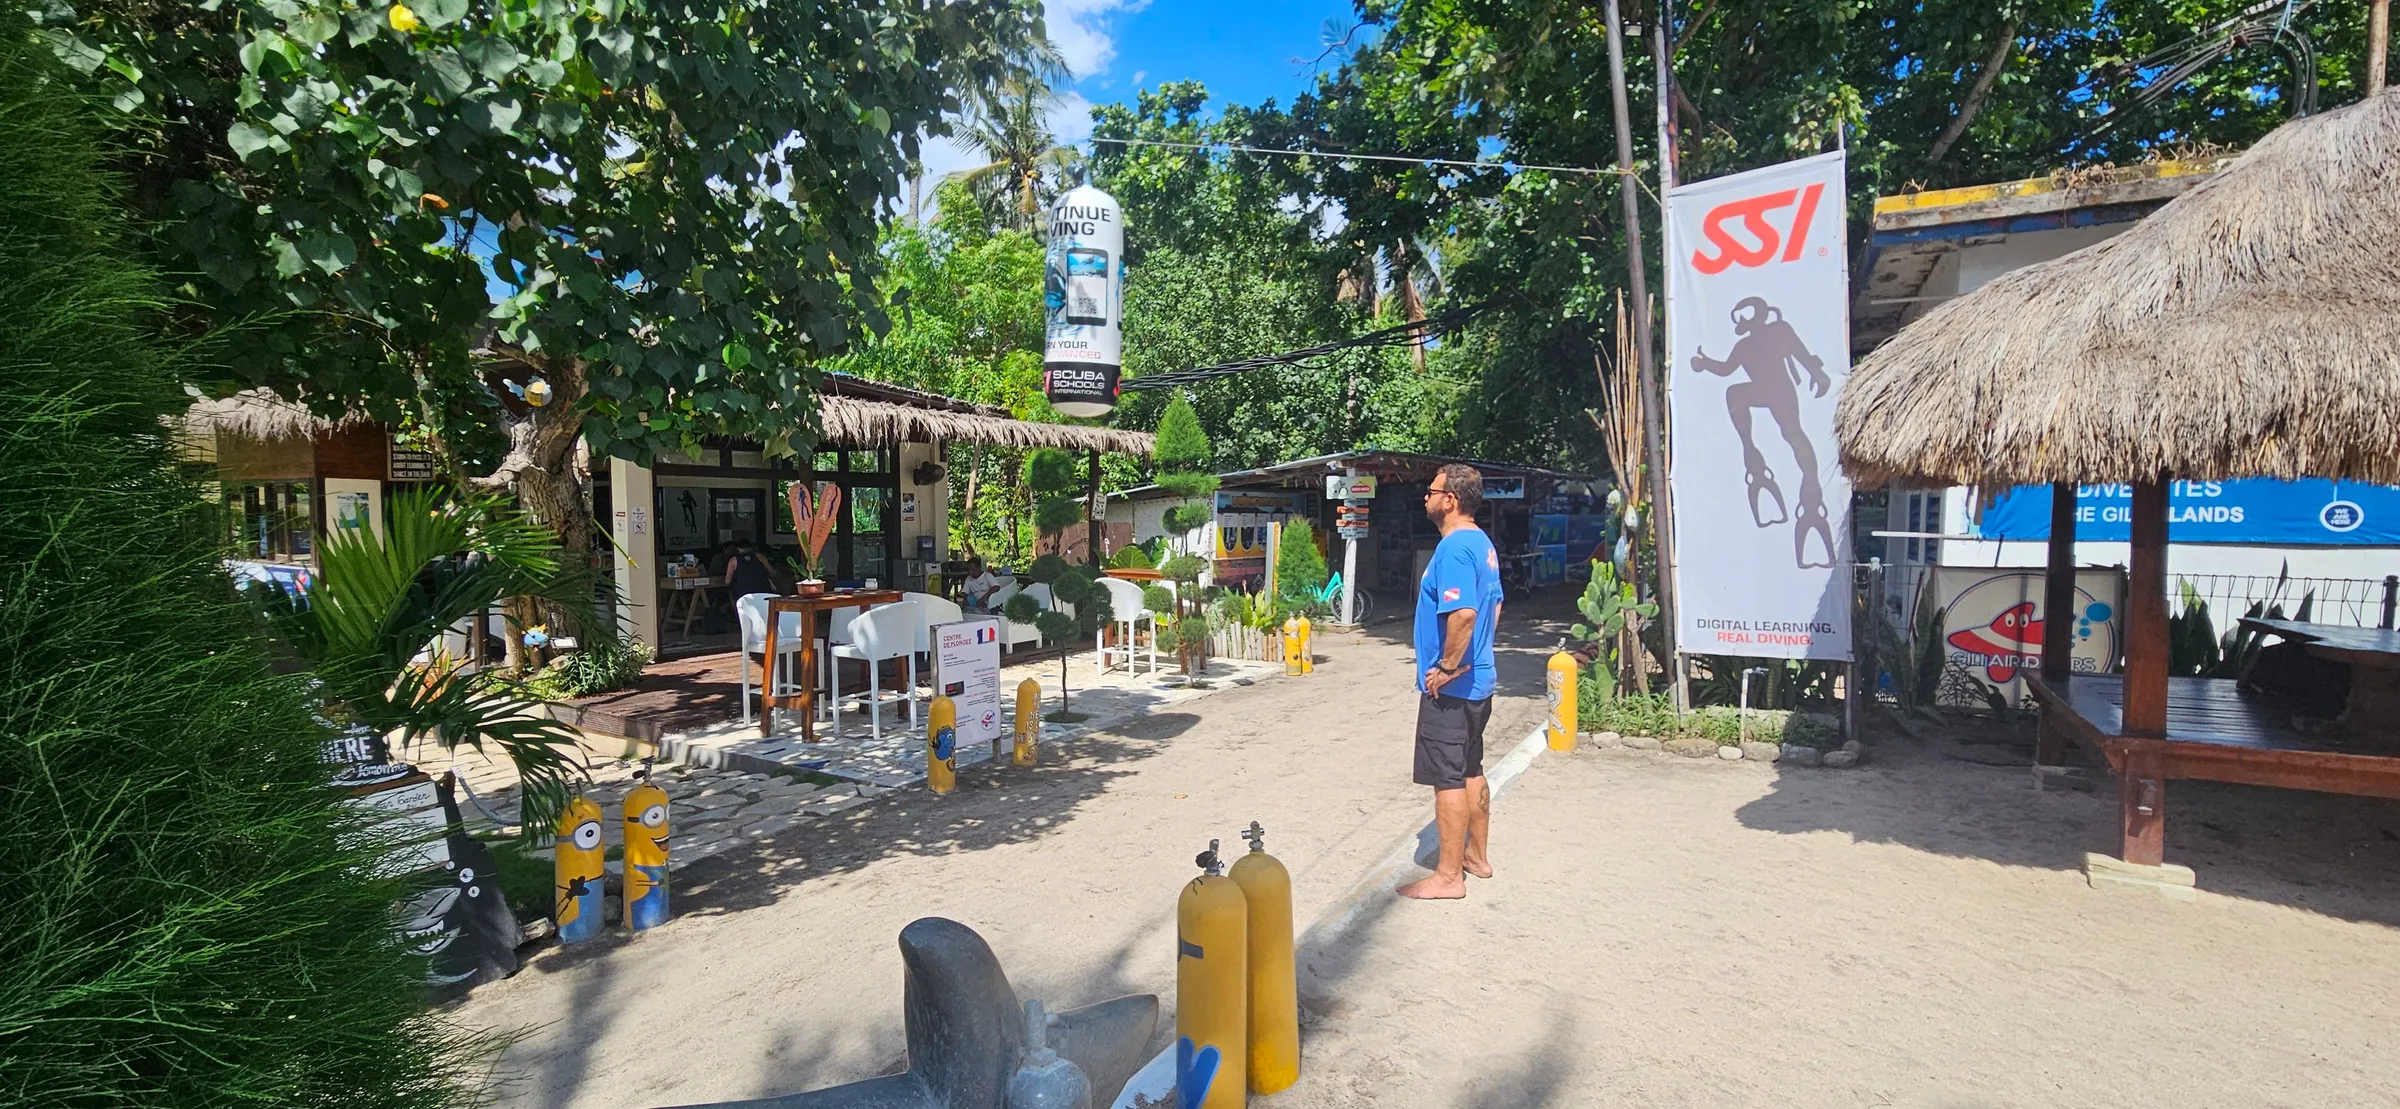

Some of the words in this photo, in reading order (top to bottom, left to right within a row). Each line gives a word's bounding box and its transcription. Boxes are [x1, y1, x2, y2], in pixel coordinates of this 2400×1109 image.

[1051, 206, 1111, 223] TINUE
[1050, 221, 1095, 237] VING
[1691, 182, 1825, 275] SSI
[1058, 340, 1088, 349] YOUR
[1052, 370, 1105, 381] SCUBA
[1053, 380, 1105, 389] SCHOOLS
[1054, 388, 1104, 396] INTERNATIONAL
[2171, 480, 2223, 498] TES
[2075, 506, 2096, 522] HE
[2102, 506, 2132, 523] GIL
[2168, 506, 2245, 523] LANDS
[1697, 618, 1750, 631] DIGITAL
[1754, 621, 1836, 634] LEARNING.
[1717, 631, 1753, 643] REAL
[1757, 633, 1814, 646] DIVING.
[1951, 651, 1985, 666] GILI
[1988, 653, 2021, 668] AIR
[2022, 655, 2096, 672] DRS
